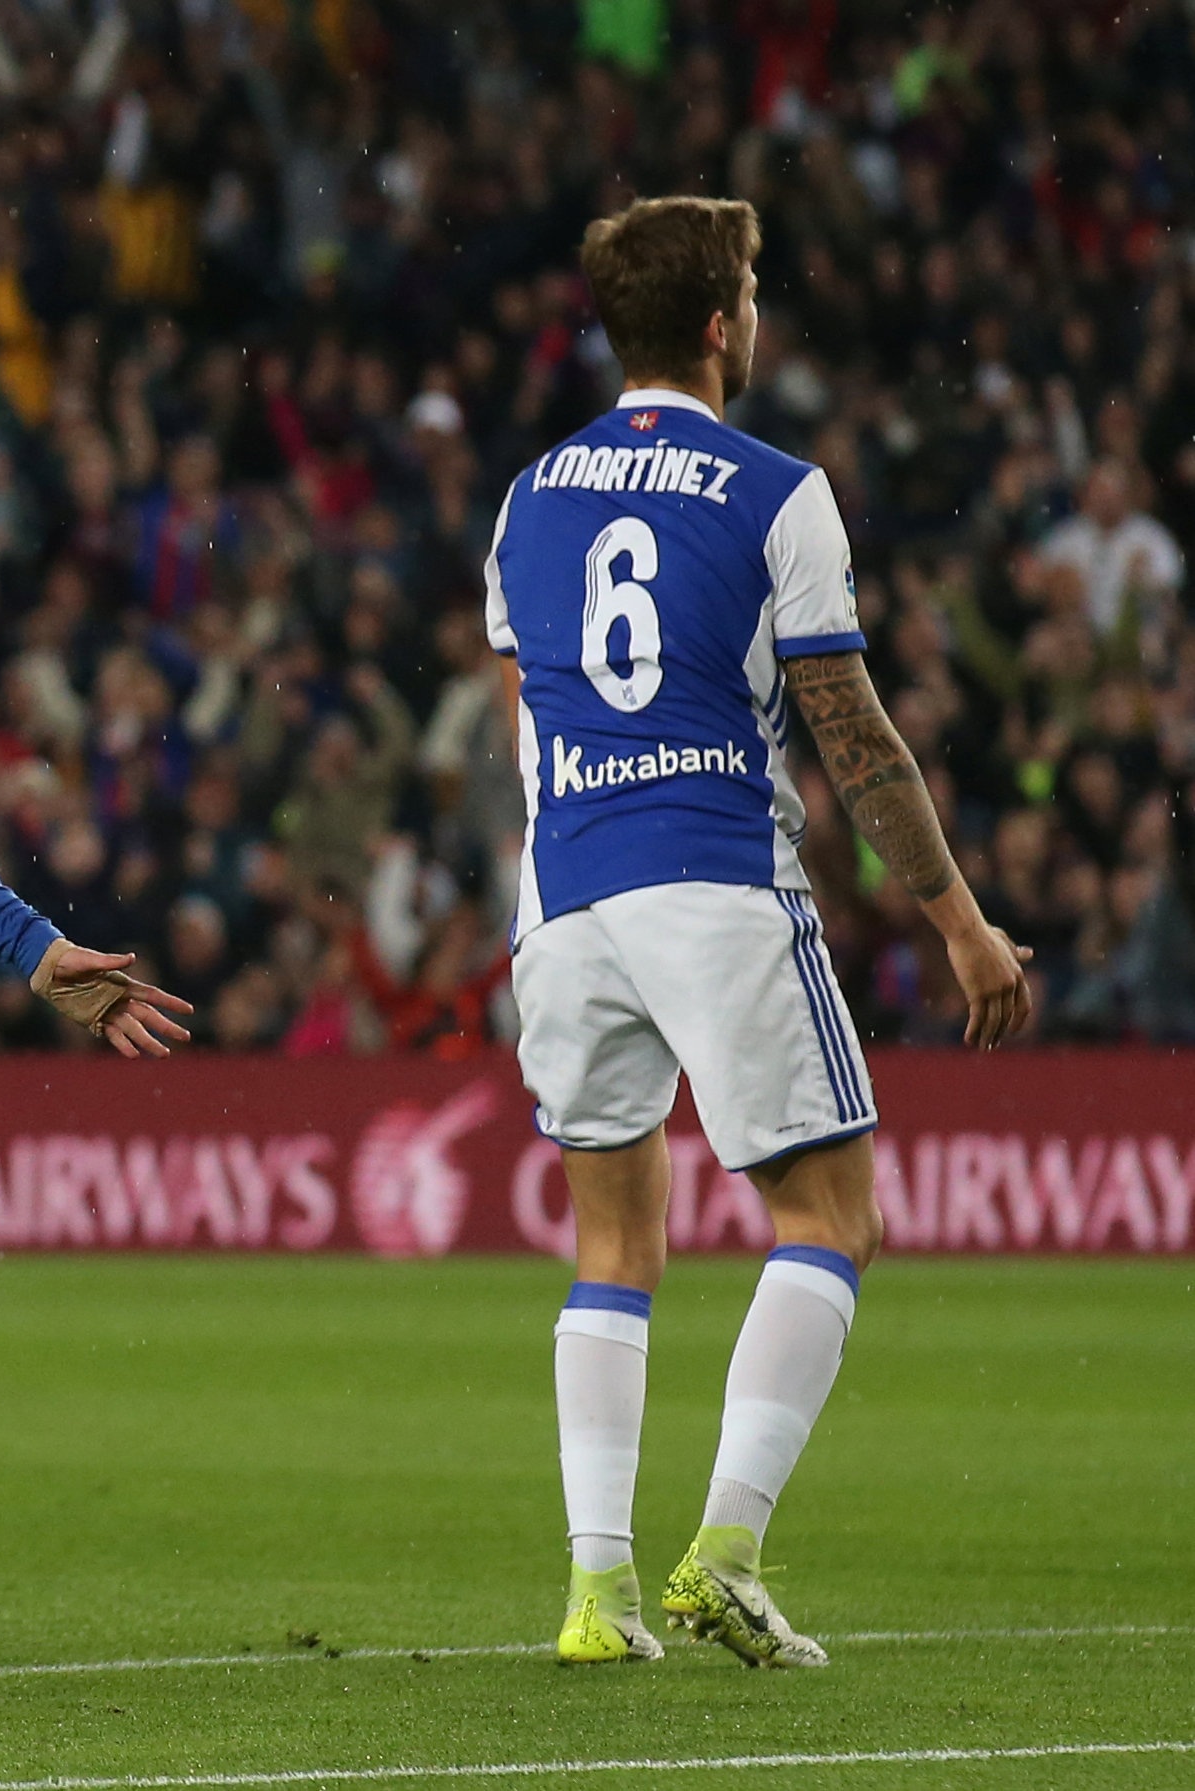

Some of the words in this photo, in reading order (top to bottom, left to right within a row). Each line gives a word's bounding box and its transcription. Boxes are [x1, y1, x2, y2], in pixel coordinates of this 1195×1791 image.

[581, 515, 664, 714] 6
[553, 734, 748, 799] Kutxabank
[874, 1133, 1195, 1248] AIRWAY
